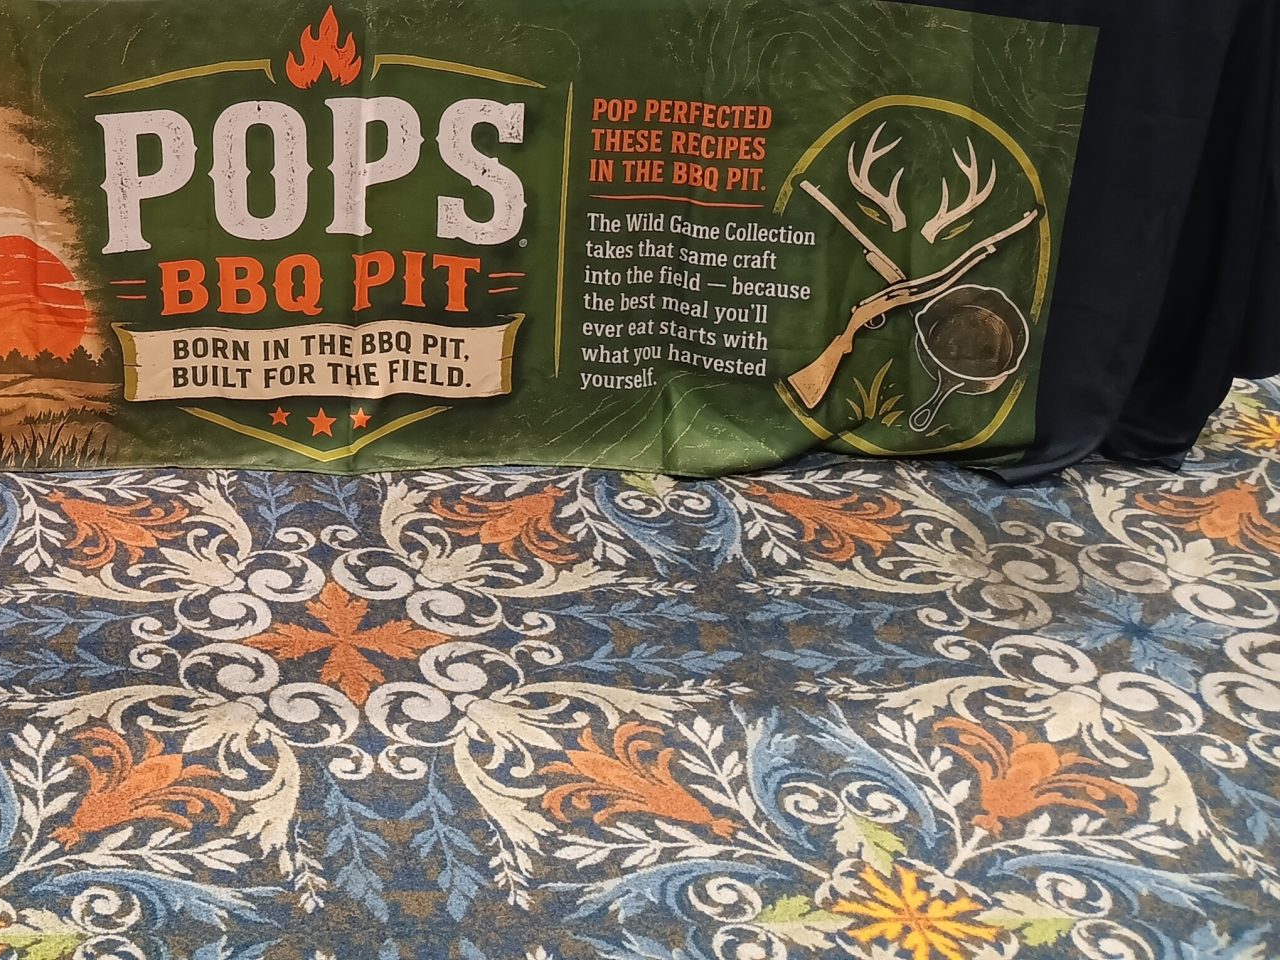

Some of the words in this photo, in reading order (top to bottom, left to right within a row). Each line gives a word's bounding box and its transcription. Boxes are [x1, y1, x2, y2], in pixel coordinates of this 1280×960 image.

[592, 99, 637, 121] POP
[645, 99, 772, 129] PERFECTED
[591, 129, 663, 153] THESE
[671, 131, 766, 160] RECIPES
[95, 96, 527, 254] POPS
[589, 159, 614, 182] IN
[622, 160, 664, 183] THE
[672, 162, 718, 192] BBQ
[726, 168, 766, 191] PIT.
[587, 212, 621, 233] The
[626, 213, 664, 232] Wild
[670, 215, 719, 239] Game
[725, 223, 816, 245] Collection
[586, 241, 633, 259] takes
[638, 239, 673, 258] that
[679, 247, 727, 267] same
[733, 251, 776, 269] craft
[158, 254, 323, 316] BBQ
[352, 251, 480, 312] PIT
[584, 266, 621, 285] into
[627, 266, 653, 284] the
[660, 266, 700, 291] field
[732, 277, 810, 299] because
[584, 293, 614, 311] the
[620, 293, 655, 311] best
[662, 296, 708, 318] meal
[714, 304, 767, 324] you'll
[174, 337, 250, 362] BORN
[264, 338, 289, 362] IN
[301, 334, 353, 357] THE
[361, 331, 411, 355] BBQ
[423, 335, 470, 362] PIT,
[582, 322, 623, 337] ever
[628, 319, 654, 335] eat
[660, 319, 716, 346] starts
[723, 331, 768, 351] with
[173, 366, 251, 388] BUILT
[264, 365, 314, 388] FOR
[327, 362, 377, 386] THE
[388, 361, 471, 388] FIELD.
[581, 346, 629, 363] what
[633, 346, 661, 367] you
[668, 343, 766, 376] harvested
[581, 367, 657, 390] yourself.
